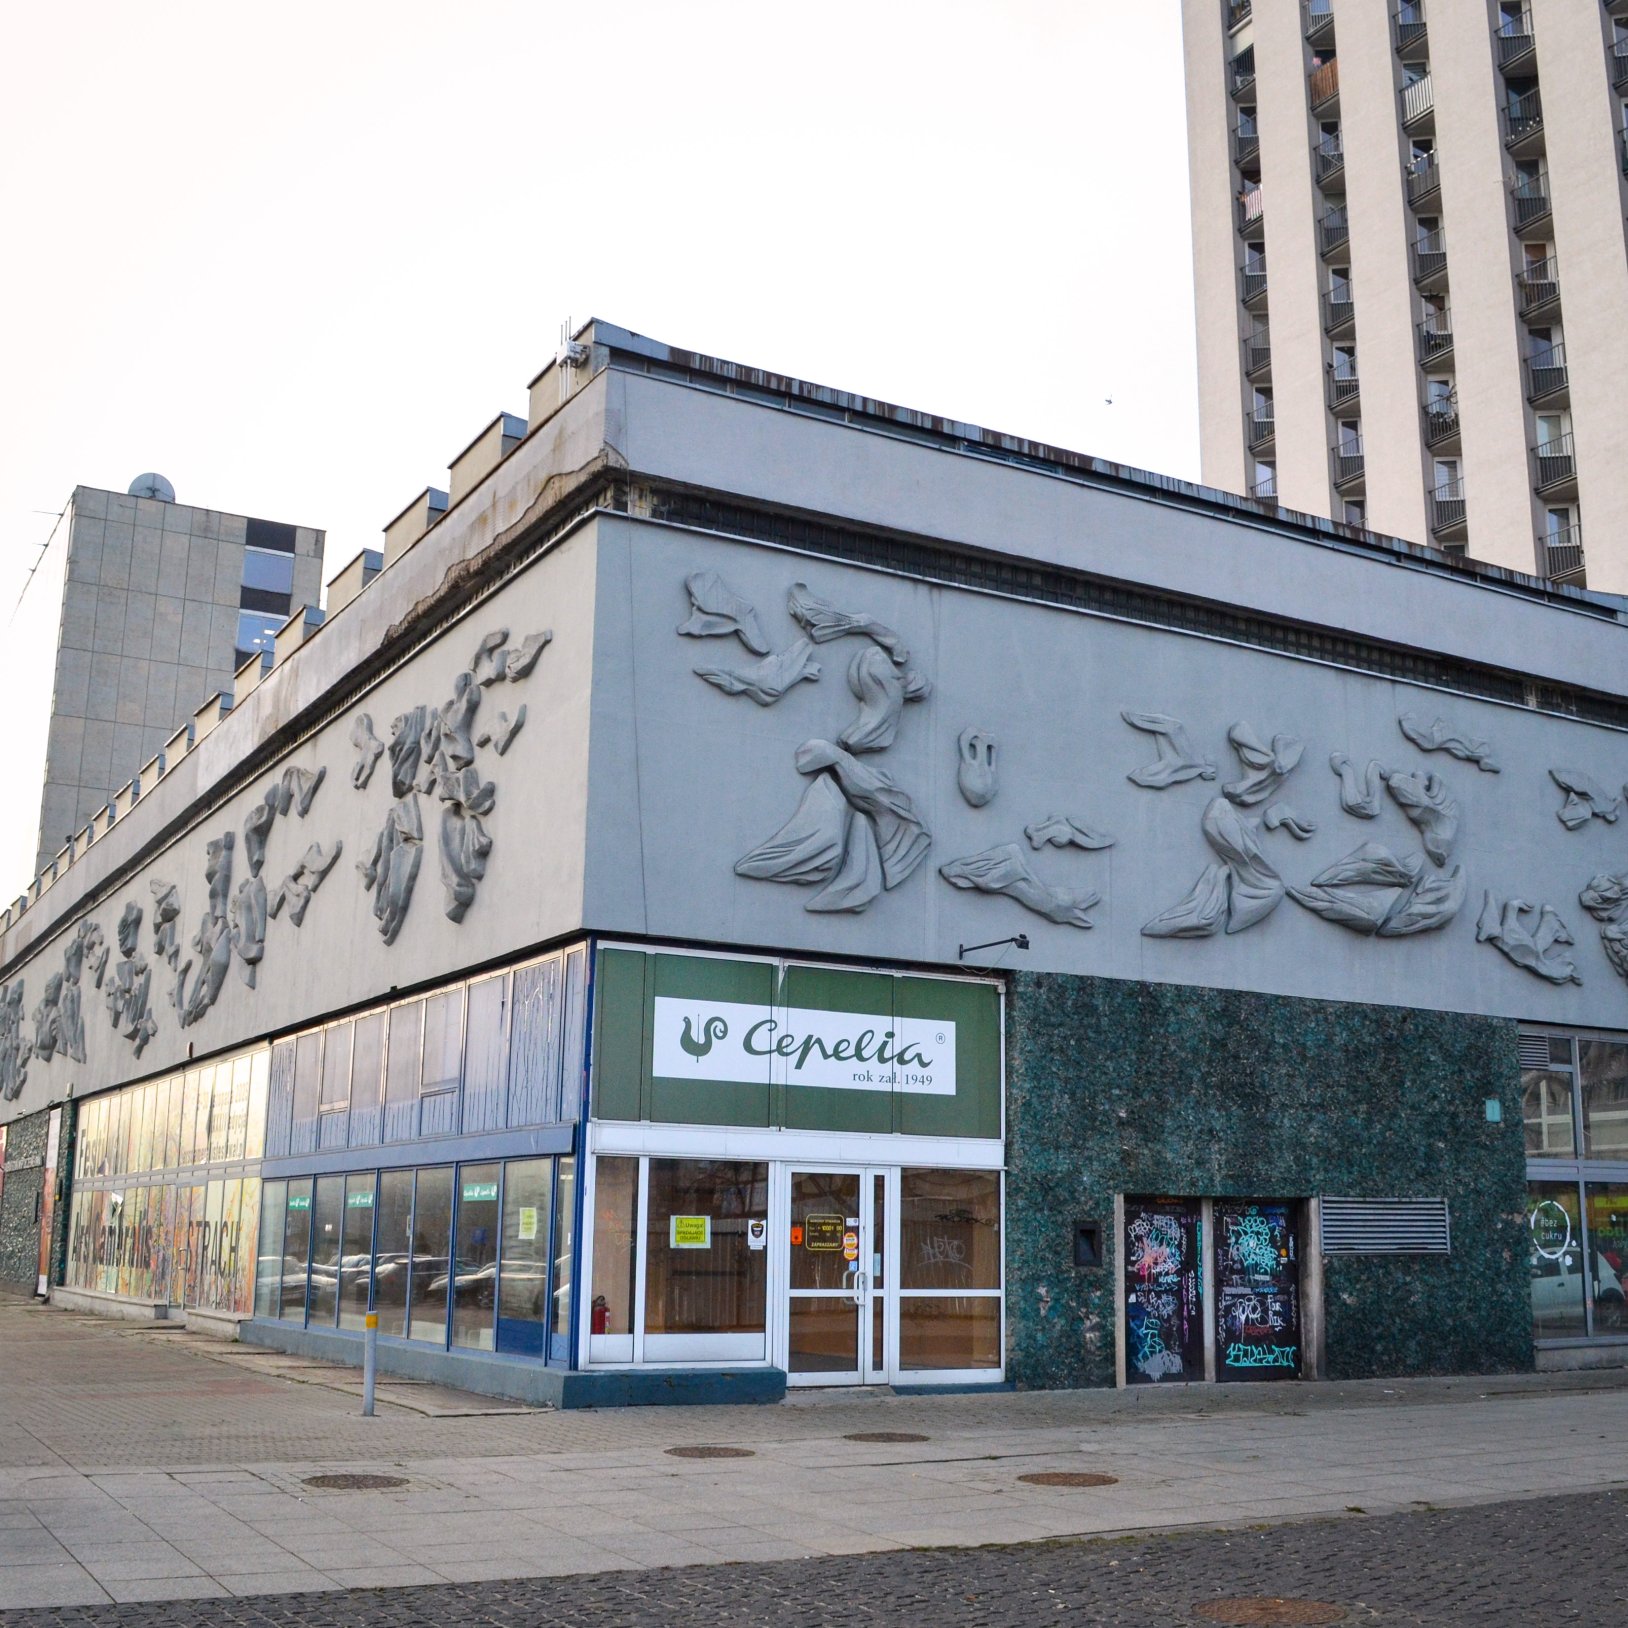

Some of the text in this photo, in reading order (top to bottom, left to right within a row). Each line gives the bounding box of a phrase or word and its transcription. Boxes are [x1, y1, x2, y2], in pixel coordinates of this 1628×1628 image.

[742, 1018, 934, 1071] Cepelia
[852, 1070, 875, 1083] rok
[904, 1073, 934, 1086] 1949
[187, 1218, 240, 1279] STRACH
